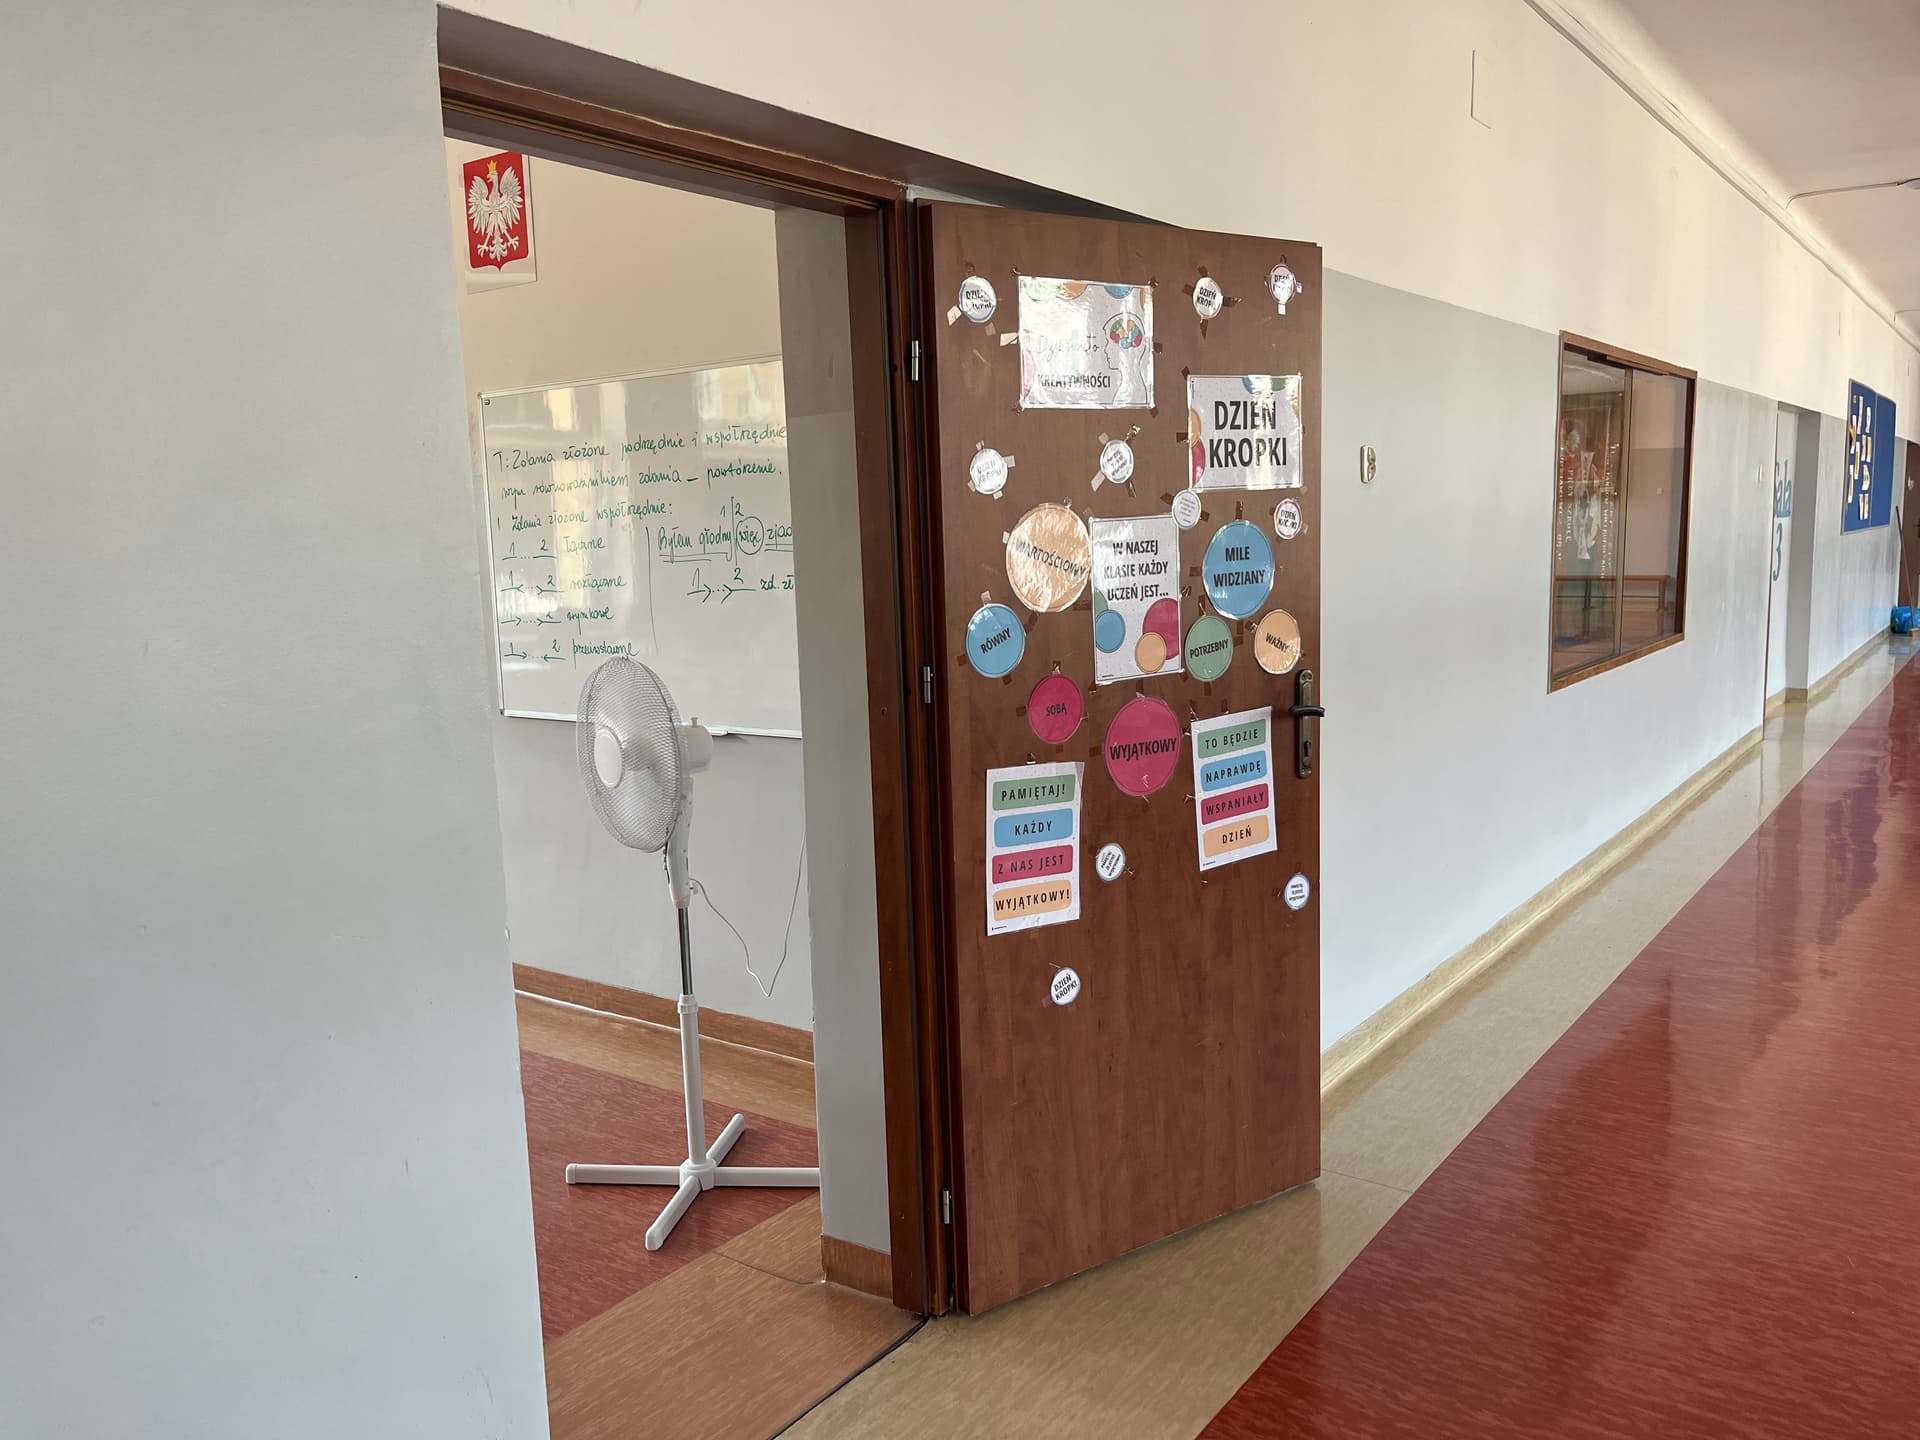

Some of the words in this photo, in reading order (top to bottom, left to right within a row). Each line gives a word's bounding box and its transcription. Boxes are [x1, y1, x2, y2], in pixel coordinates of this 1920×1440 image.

[1209, 438, 1287, 468] KROPKI
[1016, 540, 1086, 577] WARTOŚCIOWY
[1113, 542, 1123, 556] W
[1126, 540, 1158, 556] NASZEJ
[1226, 546, 1250, 562] MILE
[1773, 522, 1783, 582] 3
[1104, 564, 1136, 580] KLASIE
[1138, 560, 1168, 576] KAŻDY
[1214, 570, 1266, 588] WIDZIANY
[1108, 582, 1138, 601] UCZEŃ
[980, 628, 1012, 654] RÓWNY
[1189, 638, 1229, 659] POTRZEBNY
[1265, 632, 1289, 653] WAŻNY
[1045, 702, 1067, 717] SOBĄ
[1205, 738, 1218, 750] TO
[1224, 728, 1258, 746] BĘDZIE
[1110, 738, 1177, 762] WYJĄTKOWY
[1206, 760, 1261, 783] NAPRAWDĘ
[1002, 784, 1066, 802] PAMIĘTAJ!
[1206, 792, 1264, 816] WSPANIAŁY
[1015, 820, 1052, 836] KAŻDY
[1222, 825, 1252, 844] DZIEŃ
[998, 863, 1004, 875] Z
[1010, 858, 1033, 874] NAS
[1040, 854, 1064, 871] JEST
[995, 888, 1070, 911] WYJĄTKOWY!
[1054, 972, 1072, 992] DZIEŃ
[1056, 980, 1078, 1000] KROPKI
